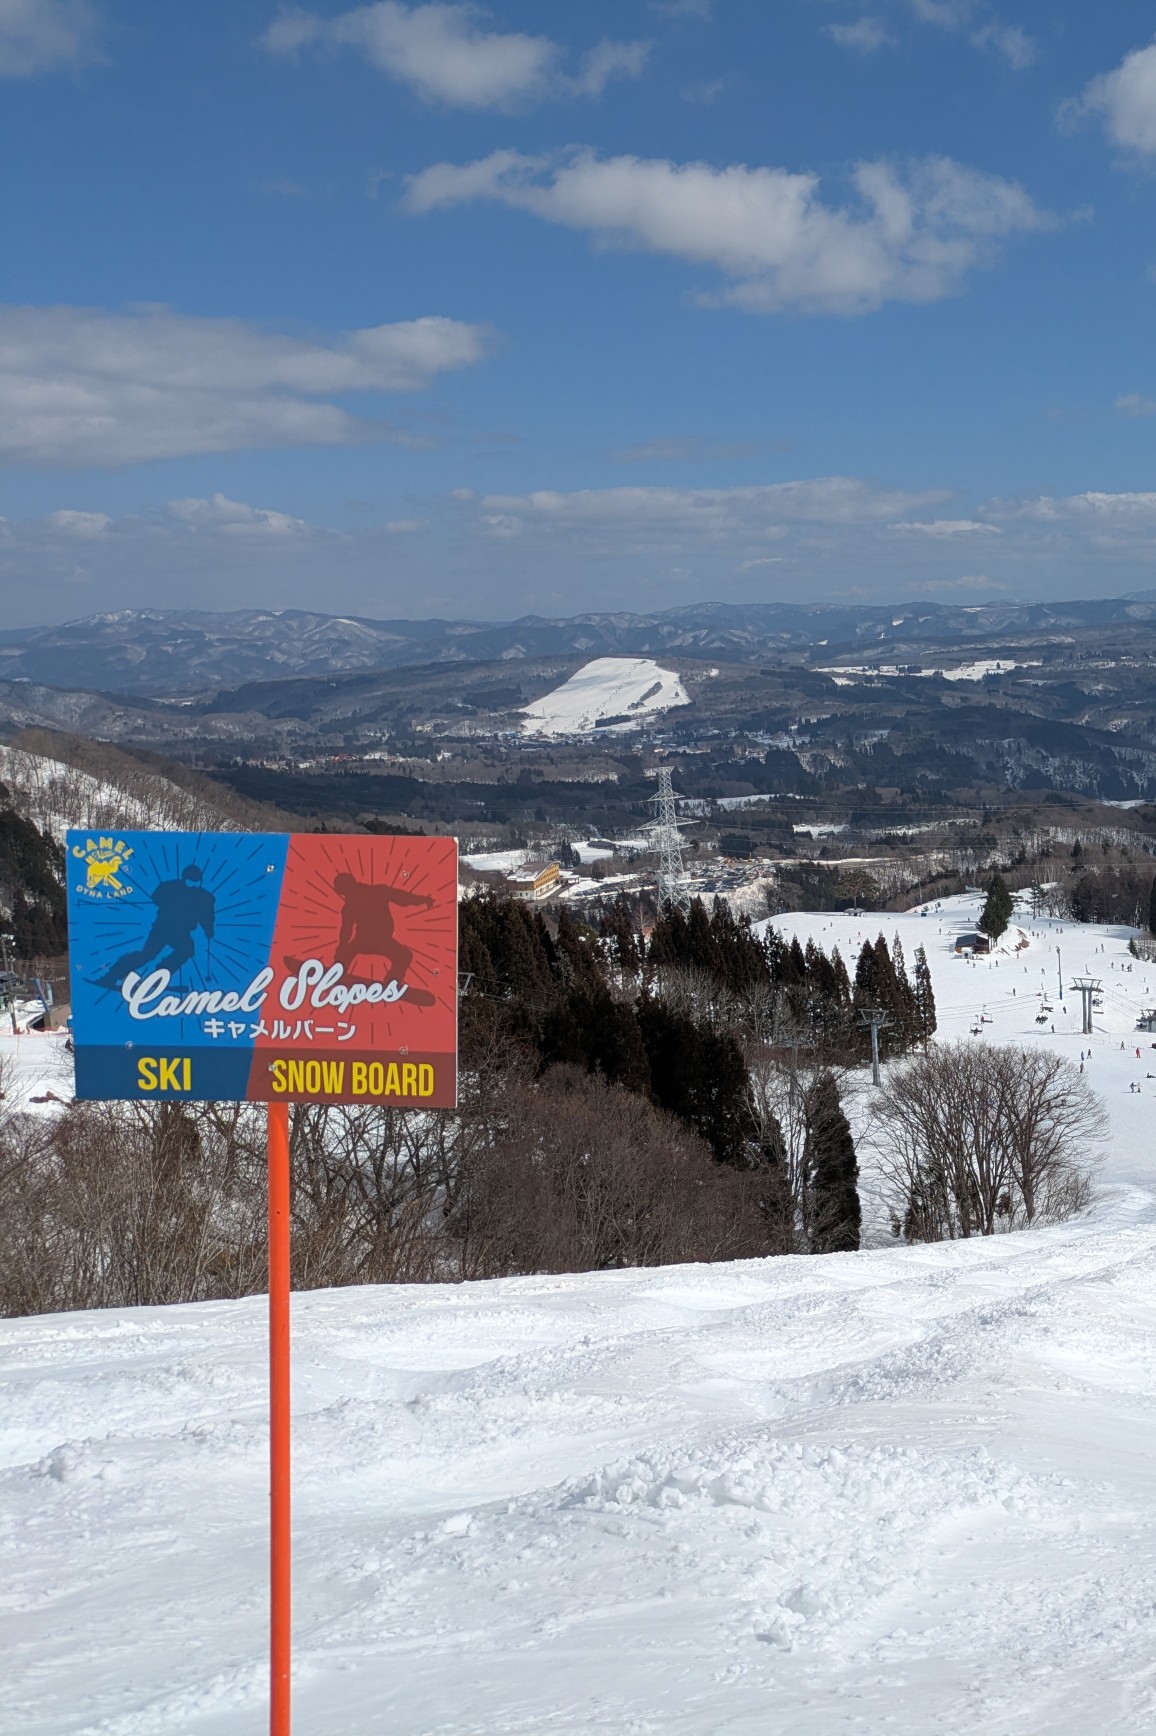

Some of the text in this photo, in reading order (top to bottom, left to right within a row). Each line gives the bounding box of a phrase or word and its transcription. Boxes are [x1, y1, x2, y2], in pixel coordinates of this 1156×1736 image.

[72, 836, 134, 861] CAMEL
[76, 884, 133, 899] DYNA LAND
[121, 958, 409, 1020] Camel Slopes
[203, 1017, 357, 1042] キャメルバーン
[137, 1057, 191, 1091] SKI
[272, 1059, 434, 1097] SNOW BOARD
